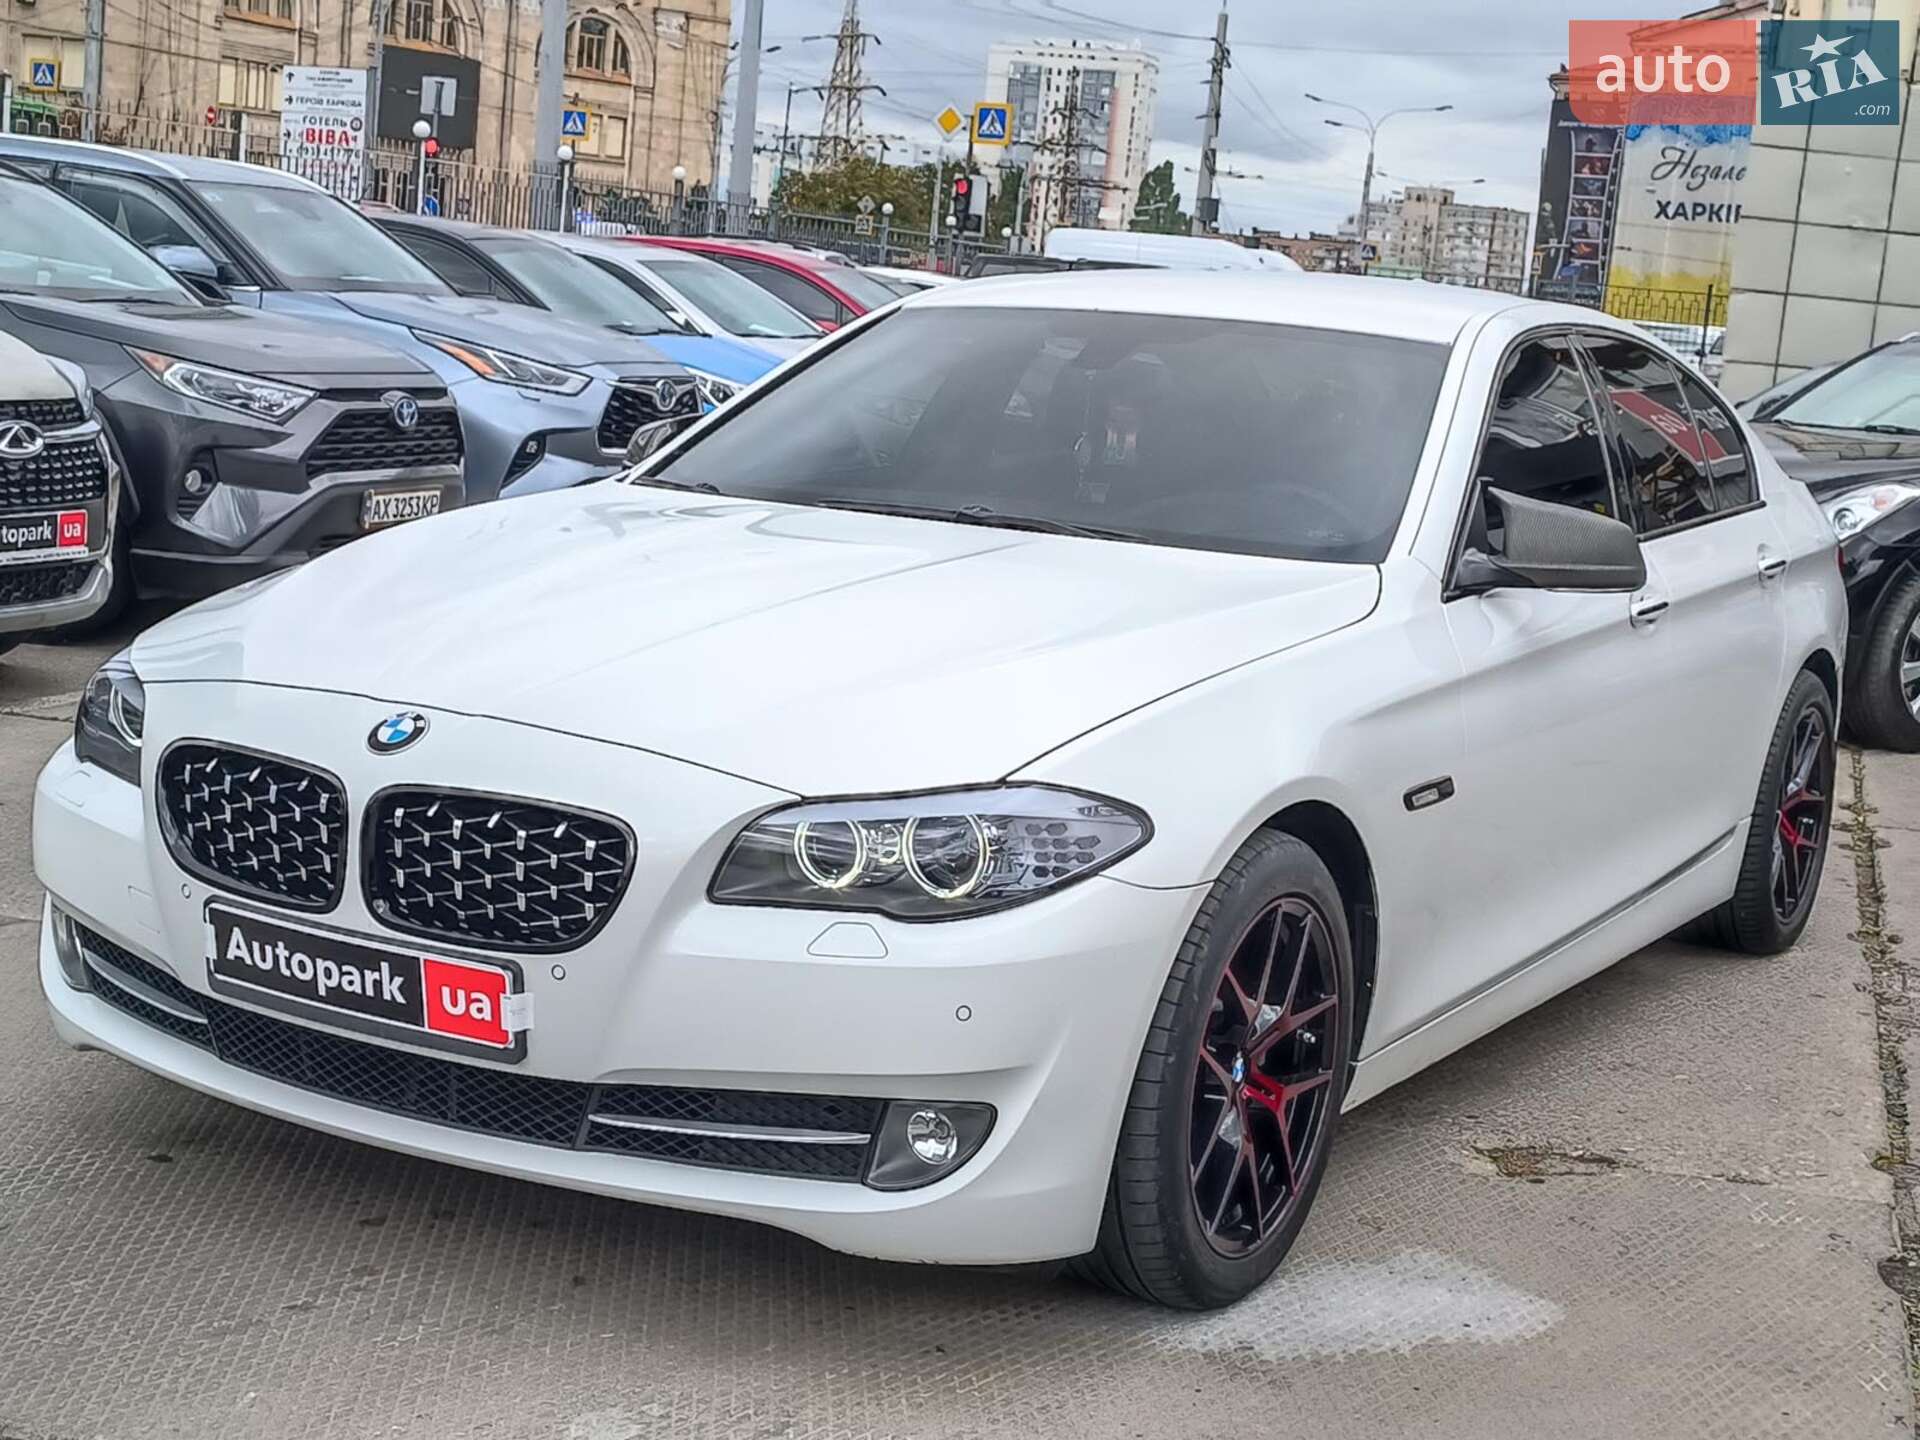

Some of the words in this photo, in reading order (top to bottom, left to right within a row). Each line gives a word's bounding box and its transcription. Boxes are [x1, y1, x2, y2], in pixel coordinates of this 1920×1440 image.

[302, 115, 347, 128] ГОТЕЛЬ
[63, 522, 81, 538] ua
[226, 926, 407, 1004] Autopark
[441, 985, 493, 1022] ua
